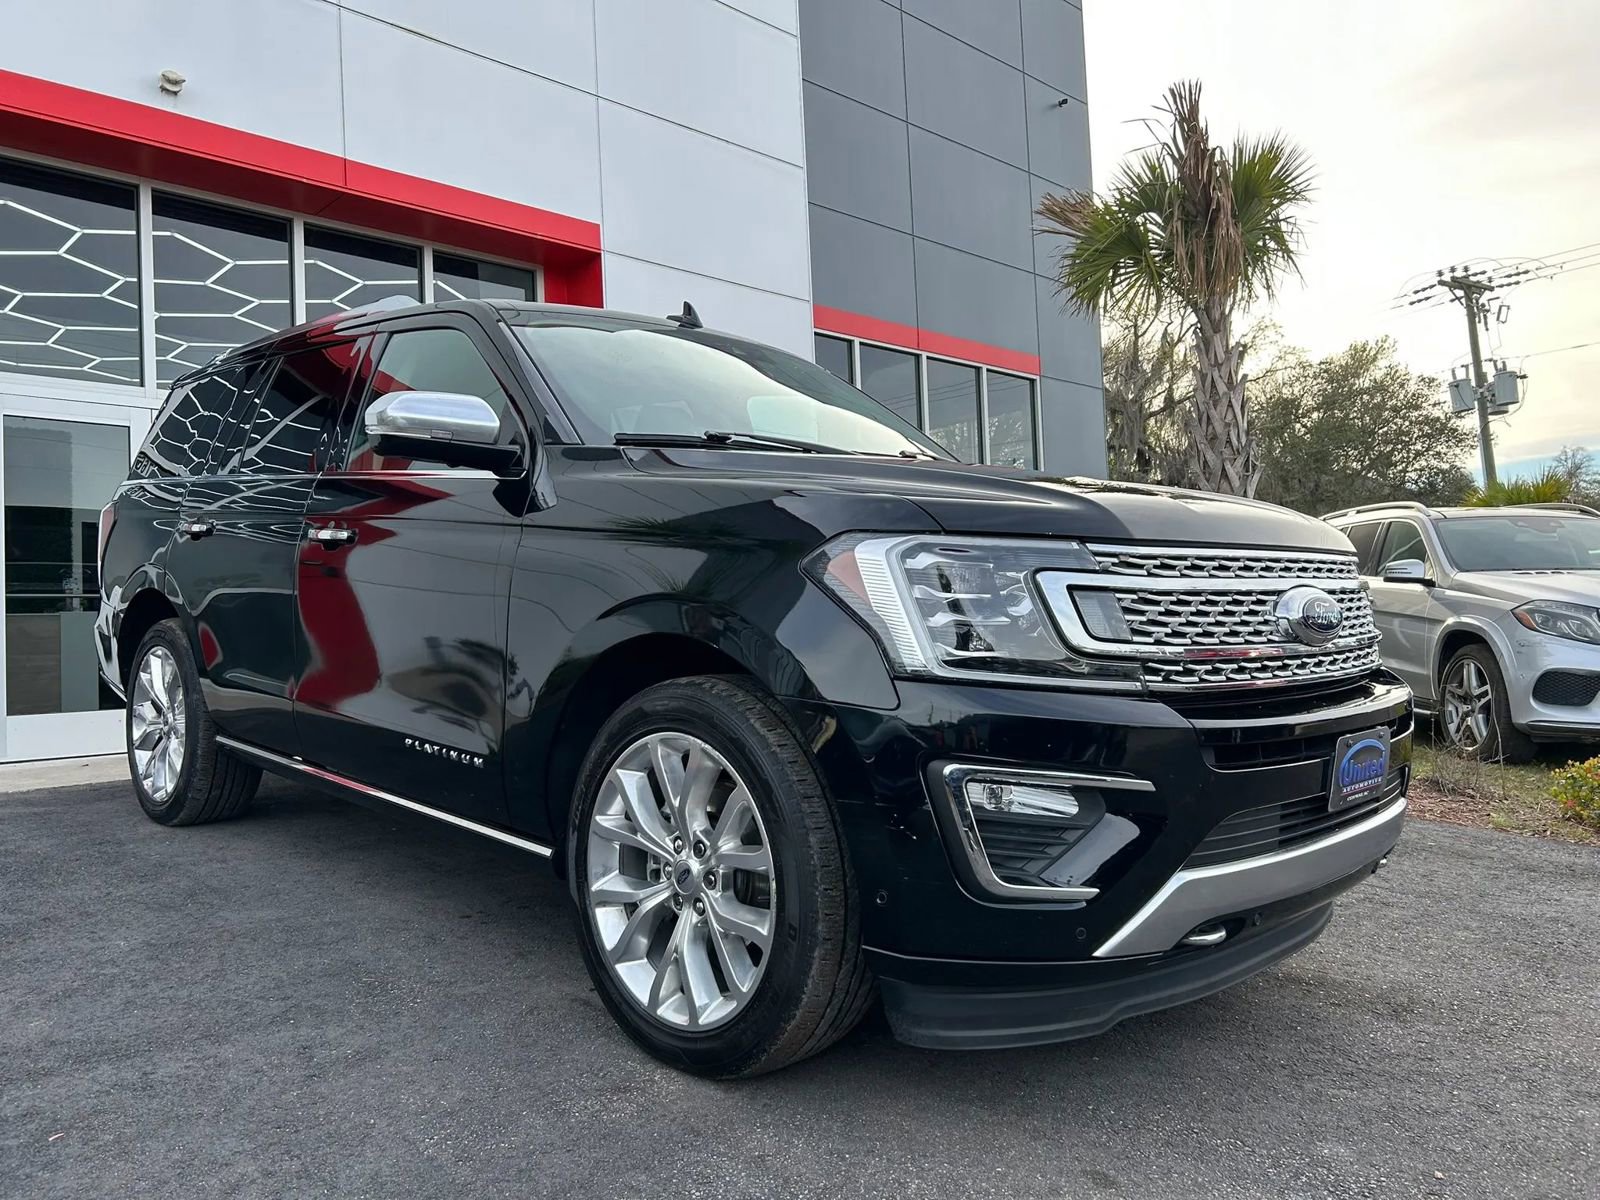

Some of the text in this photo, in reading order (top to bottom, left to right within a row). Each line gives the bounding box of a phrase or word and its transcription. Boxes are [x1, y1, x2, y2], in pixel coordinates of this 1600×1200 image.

[1310, 601, 1340, 625] Ford
[404, 738, 484, 769] PLATINUM
[1341, 751, 1385, 785] United
[1342, 776, 1382, 793] AUTOMOTIVE
